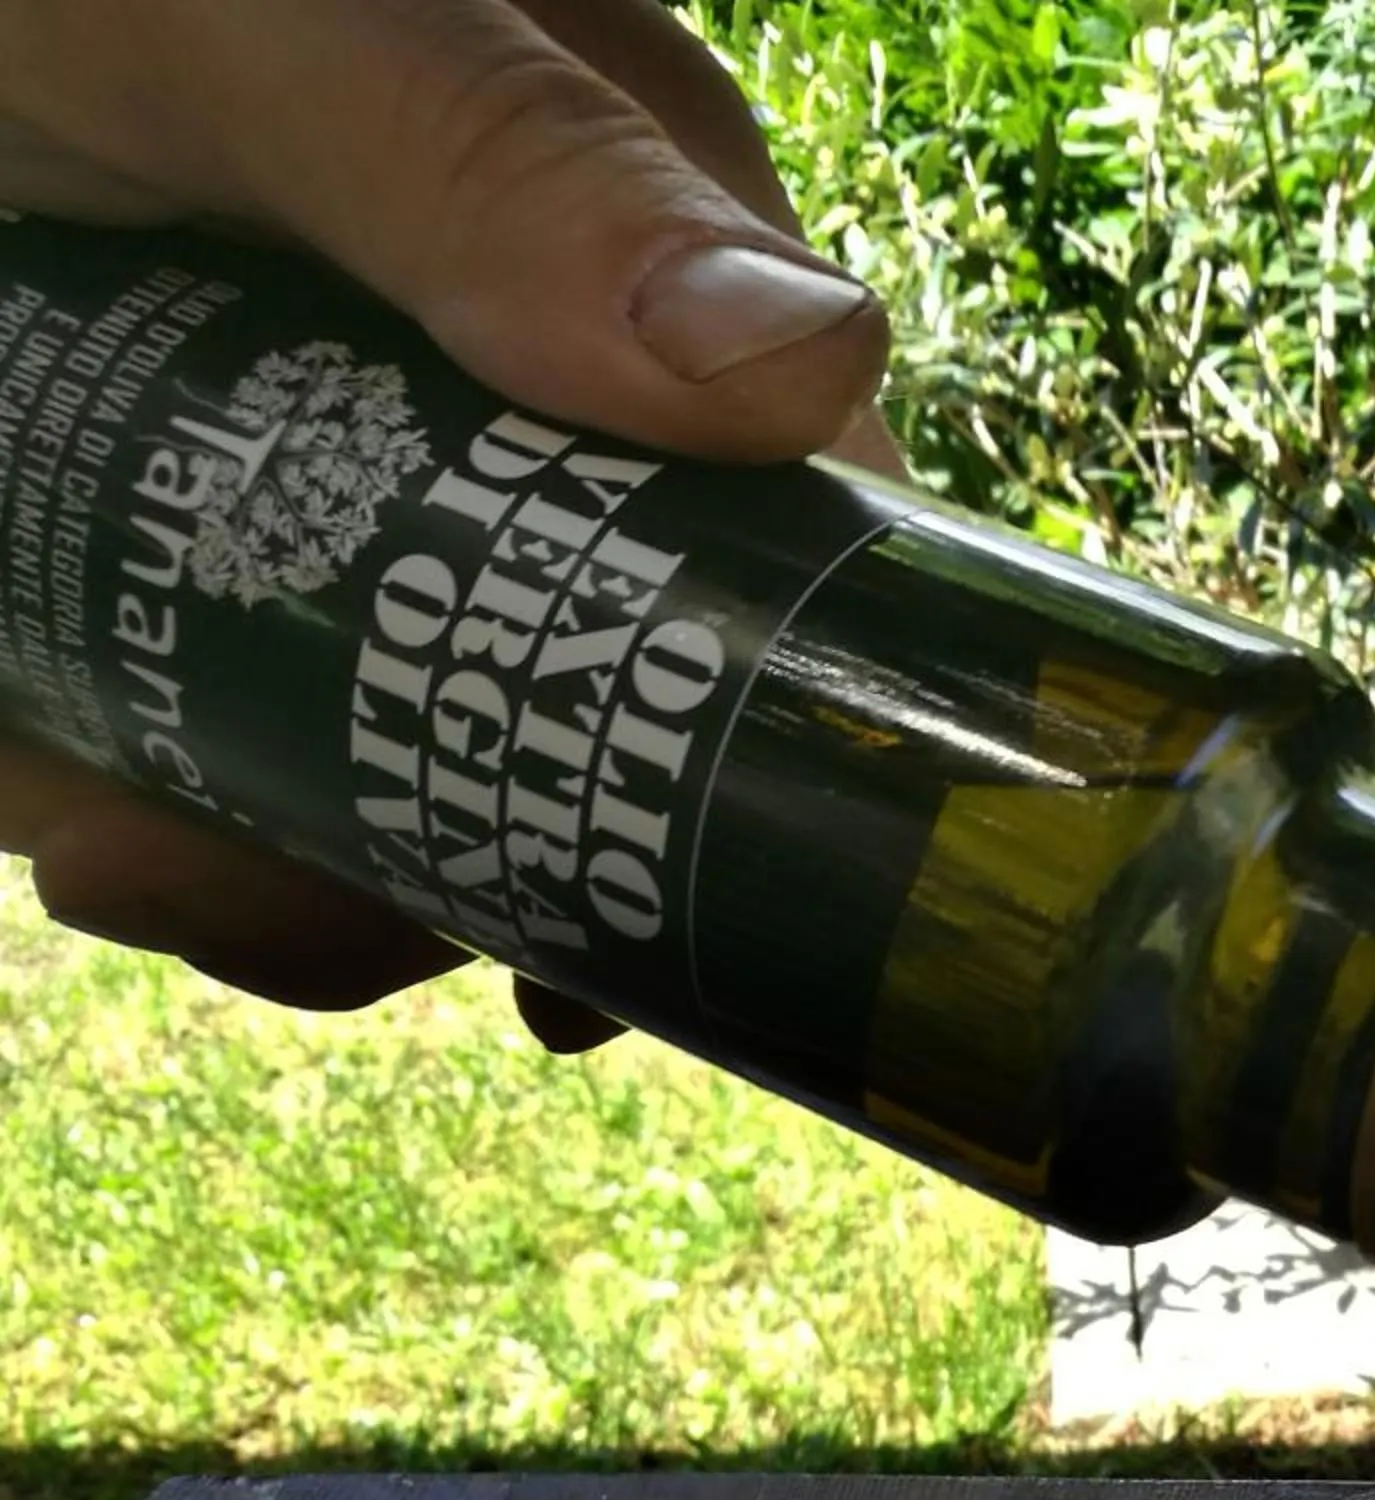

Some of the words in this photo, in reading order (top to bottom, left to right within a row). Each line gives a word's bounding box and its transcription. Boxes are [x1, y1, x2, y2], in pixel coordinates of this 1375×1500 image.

[43, 307, 83, 334] E
[64, 266, 197, 379] OTTENUTO
[166, 279, 243, 328] OLIO
[90, 322, 188, 424] D'OLIVA
[9, 377, 89, 610] DIRETTAMENTE
[73, 427, 117, 468] DI
[421, 411, 578, 532] DI
[50, 468, 101, 648] CATEGORIA
[350, 553, 460, 918] OLIVA
[506, 526, 686, 951] EXTRA
[585, 619, 724, 941] OLIO
